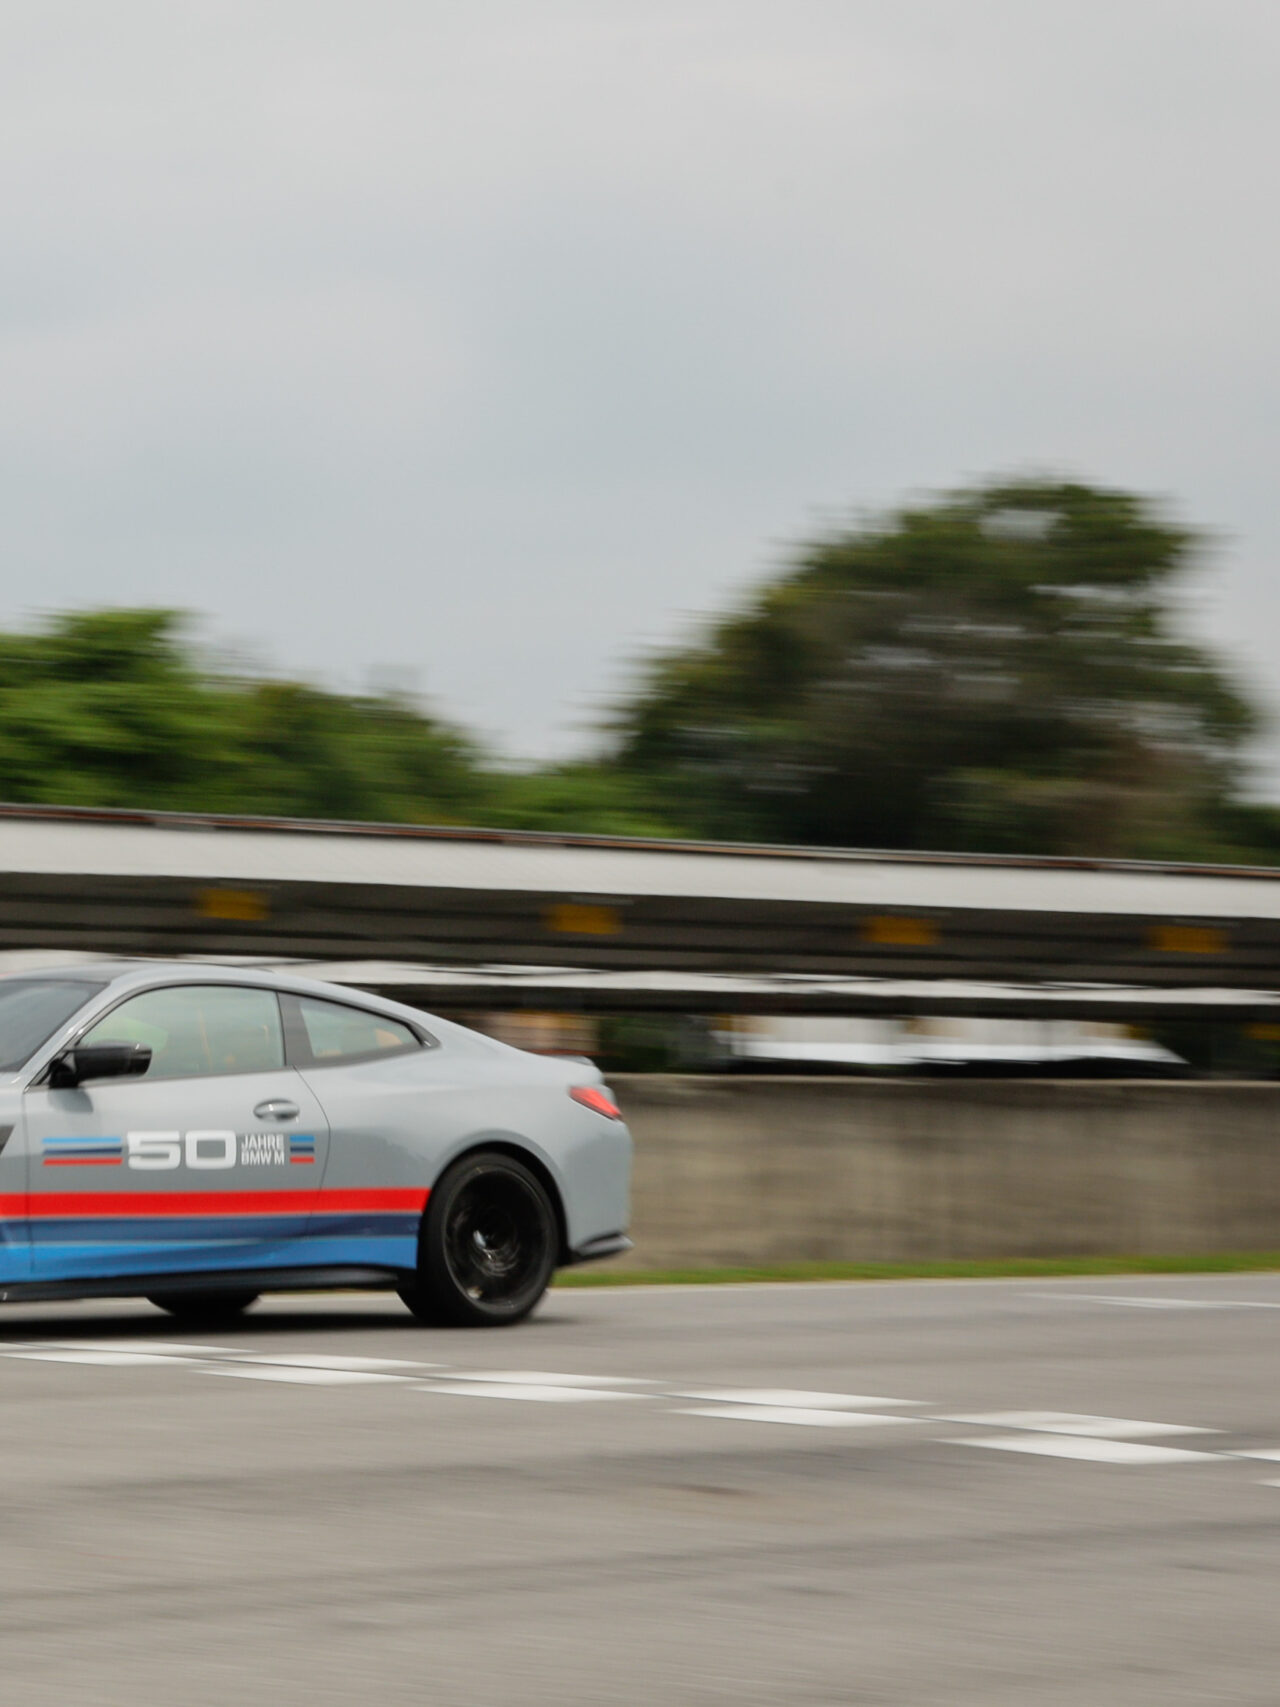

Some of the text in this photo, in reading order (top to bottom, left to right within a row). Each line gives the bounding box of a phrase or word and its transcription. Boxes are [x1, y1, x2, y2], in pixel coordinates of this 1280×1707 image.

[127, 1130, 236, 1170] 50
[241, 1134, 284, 1150] JAHRE
[241, 1150, 285, 1166] BMW M
